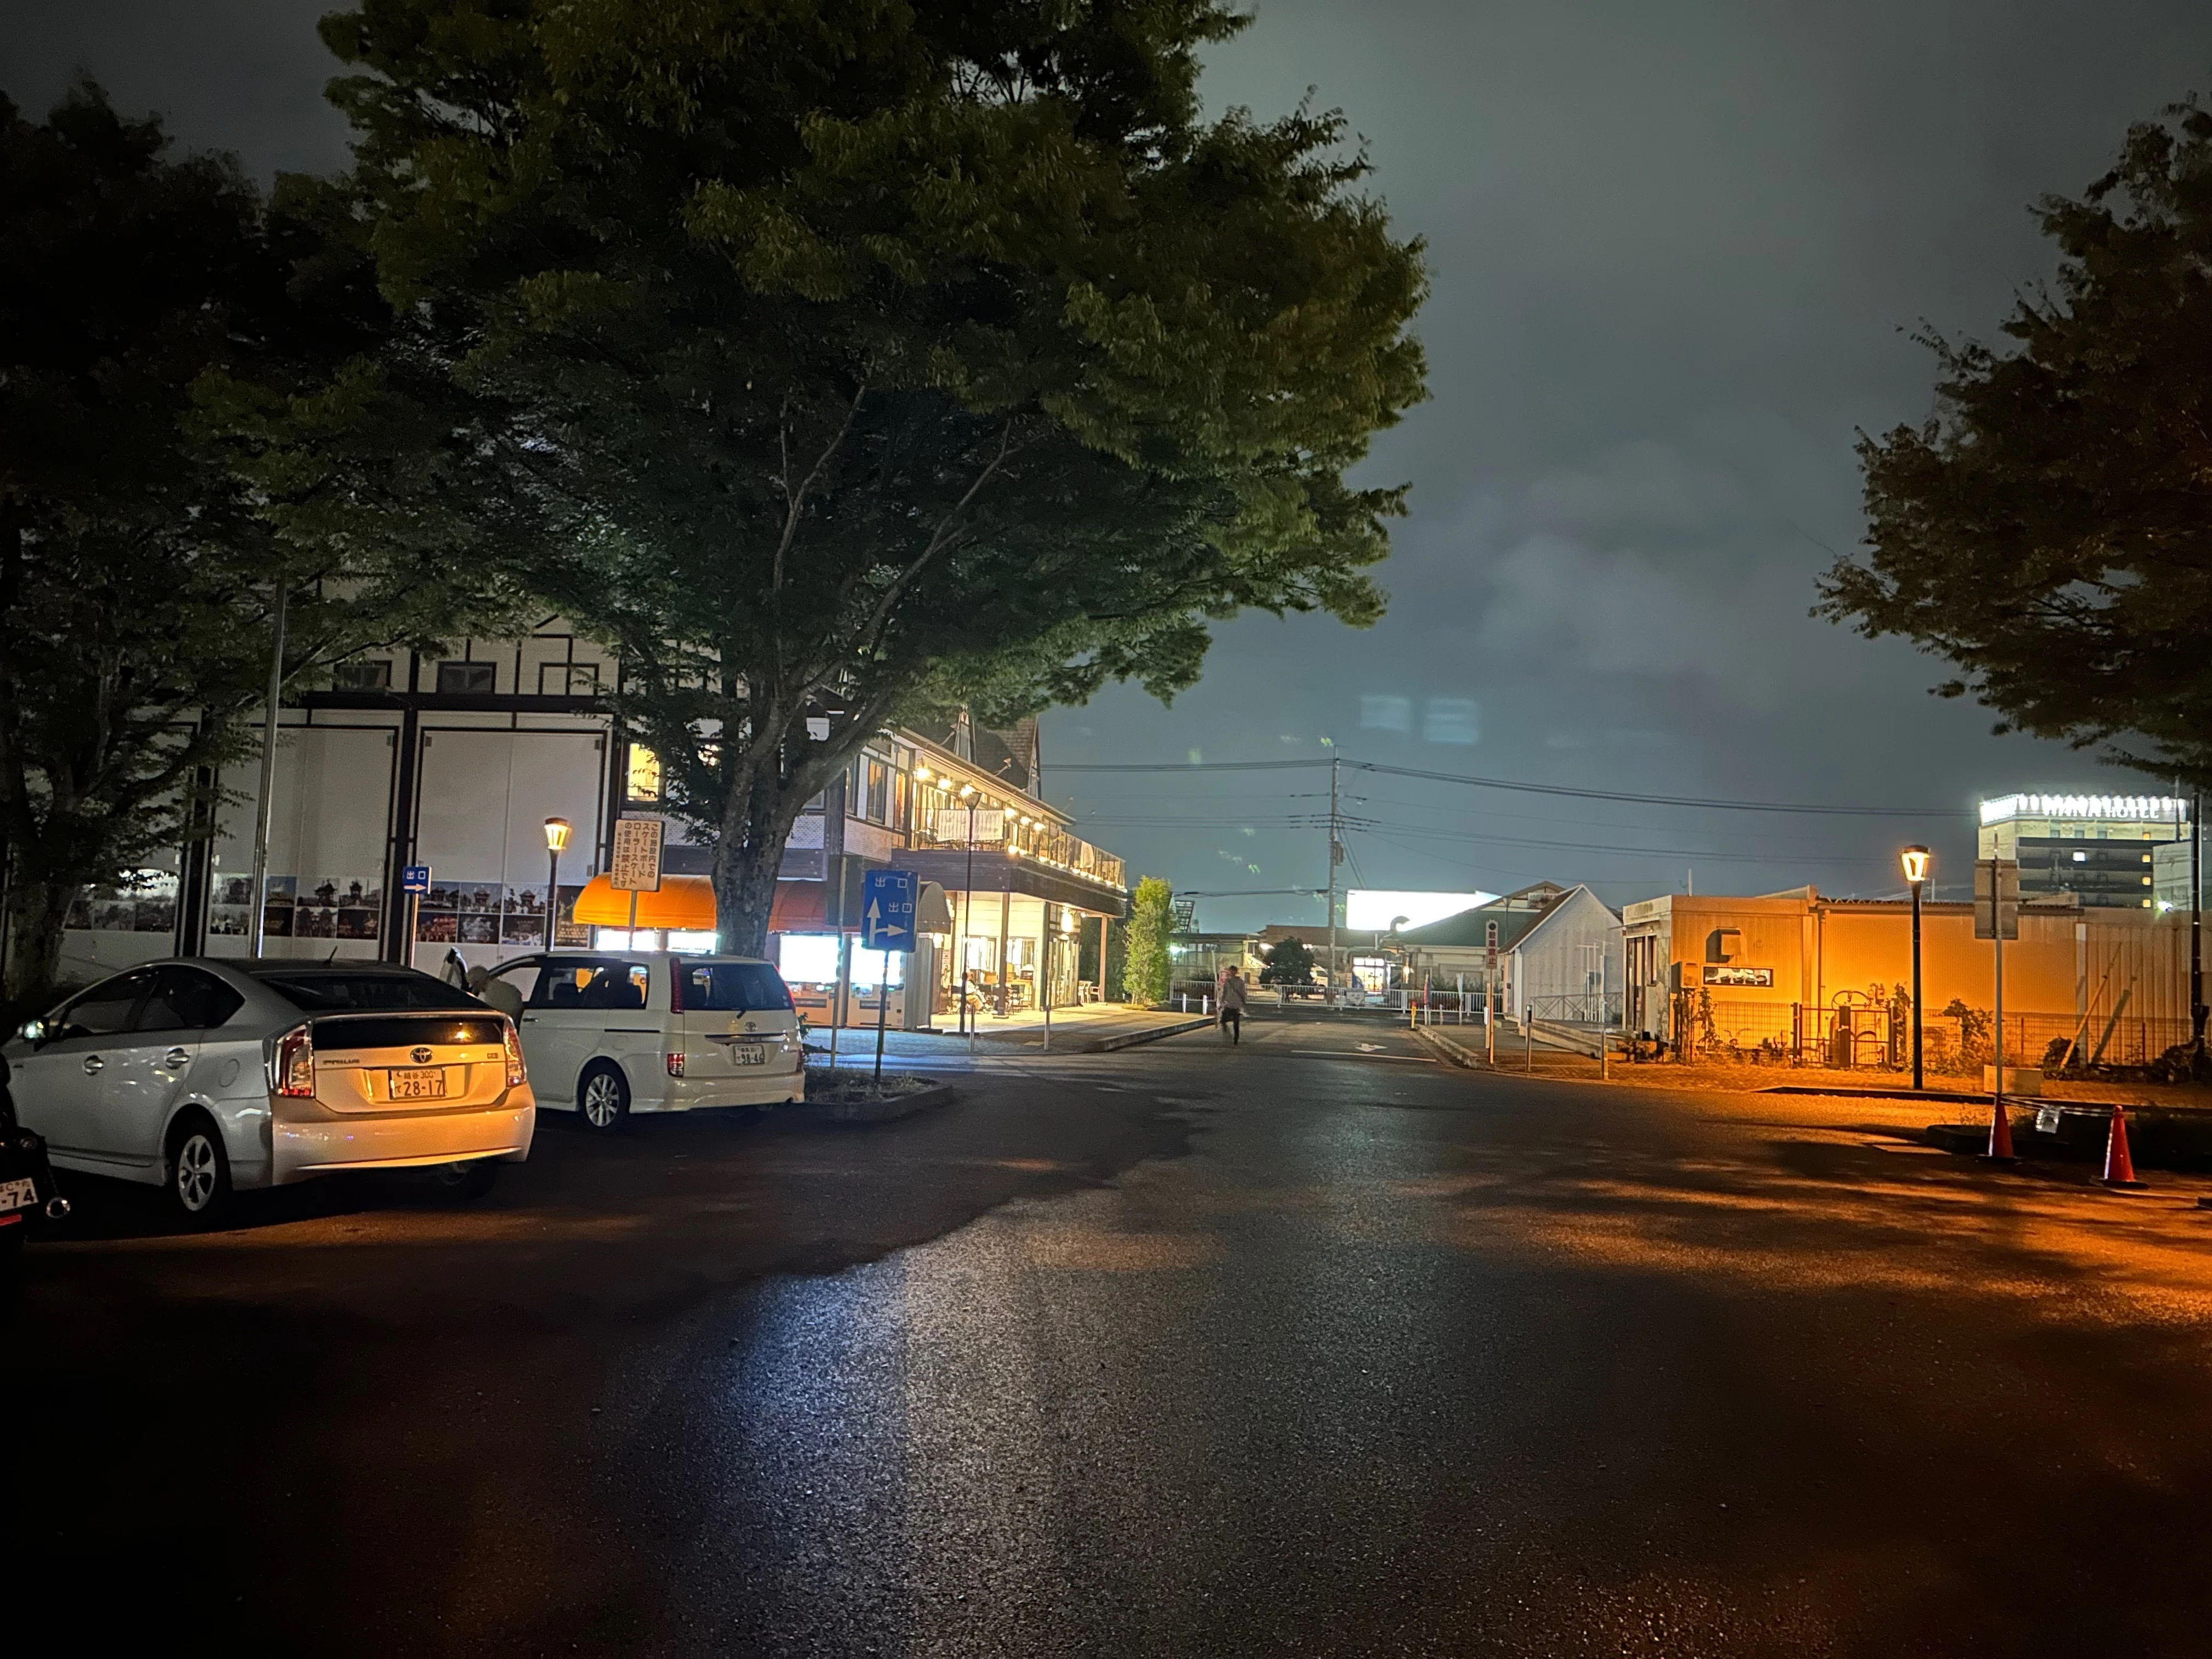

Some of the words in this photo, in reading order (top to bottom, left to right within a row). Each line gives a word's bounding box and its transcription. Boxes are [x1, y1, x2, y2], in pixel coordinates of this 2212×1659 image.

[620, 822, 632, 887] の使用は禁止です
[629, 823, 641, 885] ローラースケート
[639, 823, 650, 877] スケートボード
[647, 823, 658, 878] この施設内での
[406, 871, 426, 879] 出口
[875, 877, 907, 888] 出口
[888, 901, 912, 913] 出口
[741, 1053, 763, 1064] 98-46
[403, 1080, 442, 1096] 28-17
